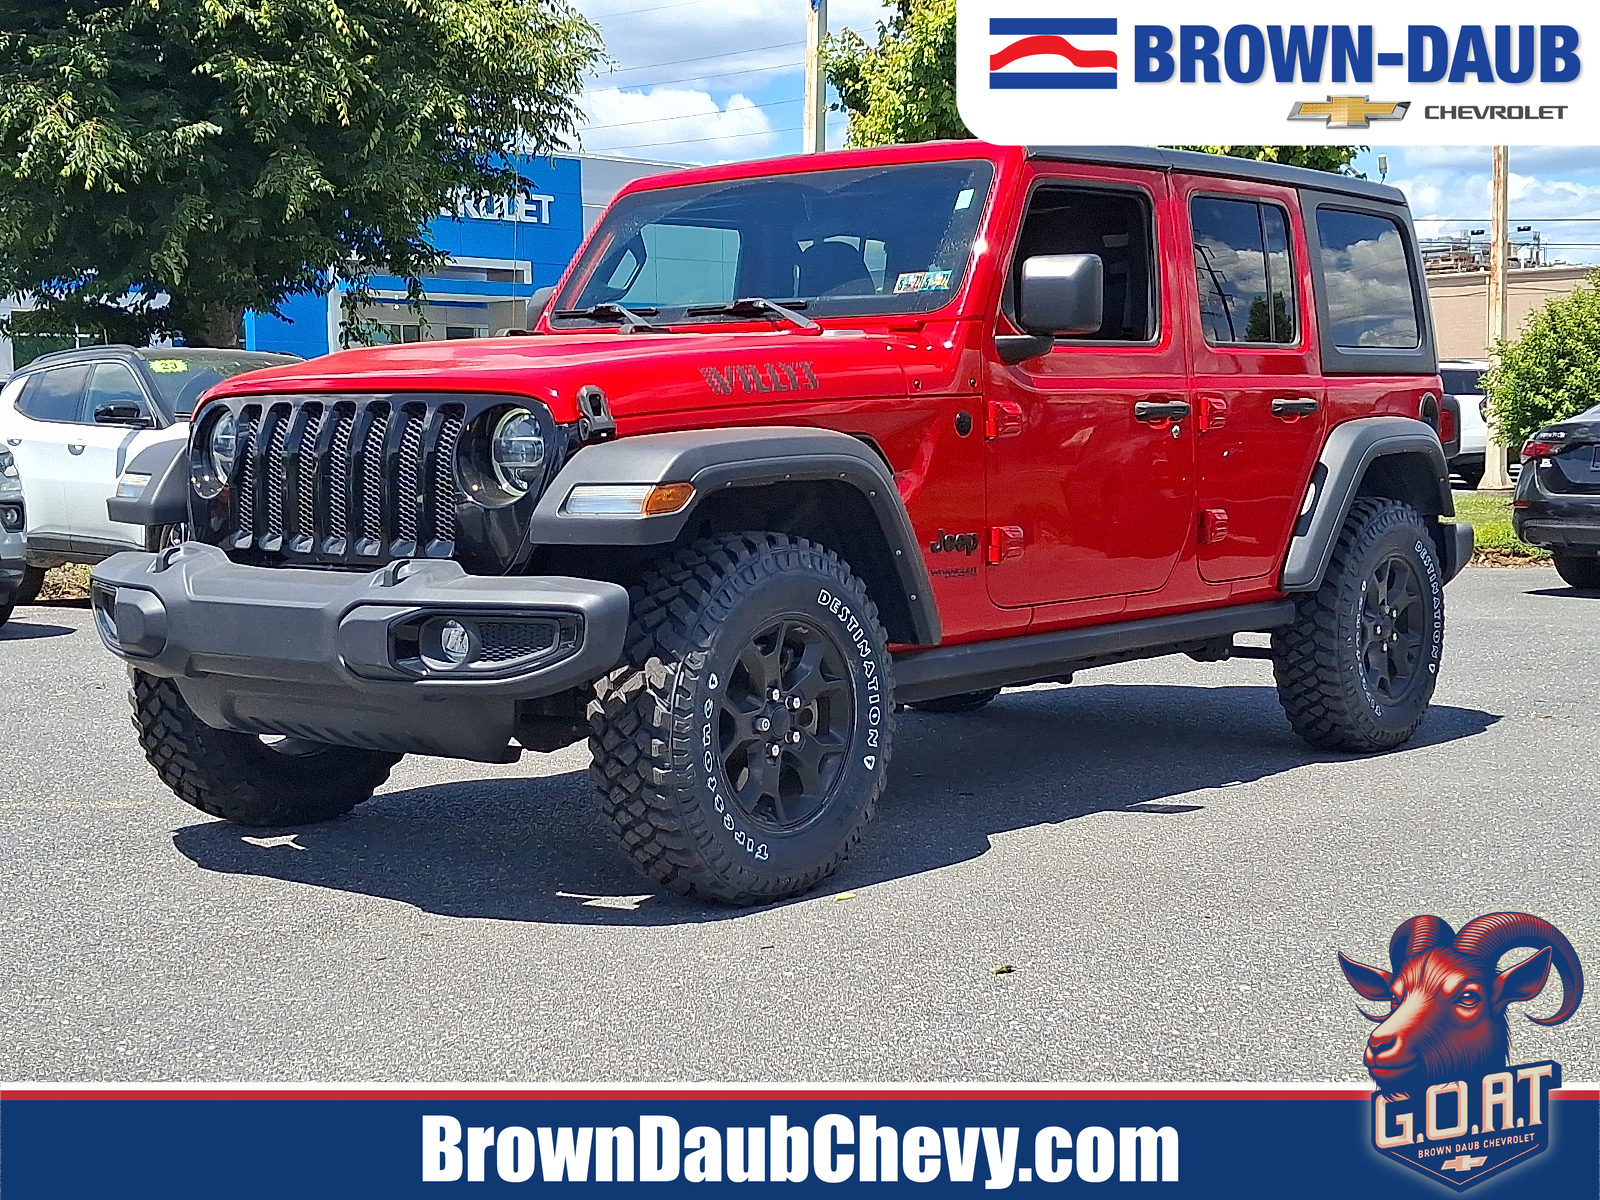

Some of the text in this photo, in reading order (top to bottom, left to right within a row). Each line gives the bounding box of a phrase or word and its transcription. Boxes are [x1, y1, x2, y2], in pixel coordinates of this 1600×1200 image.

[698, 361, 819, 395] WILLYS
[929, 528, 978, 556] Jeep
[1414, 539, 1442, 659] DESTINATION
[817, 588, 880, 748] DESTINATION
